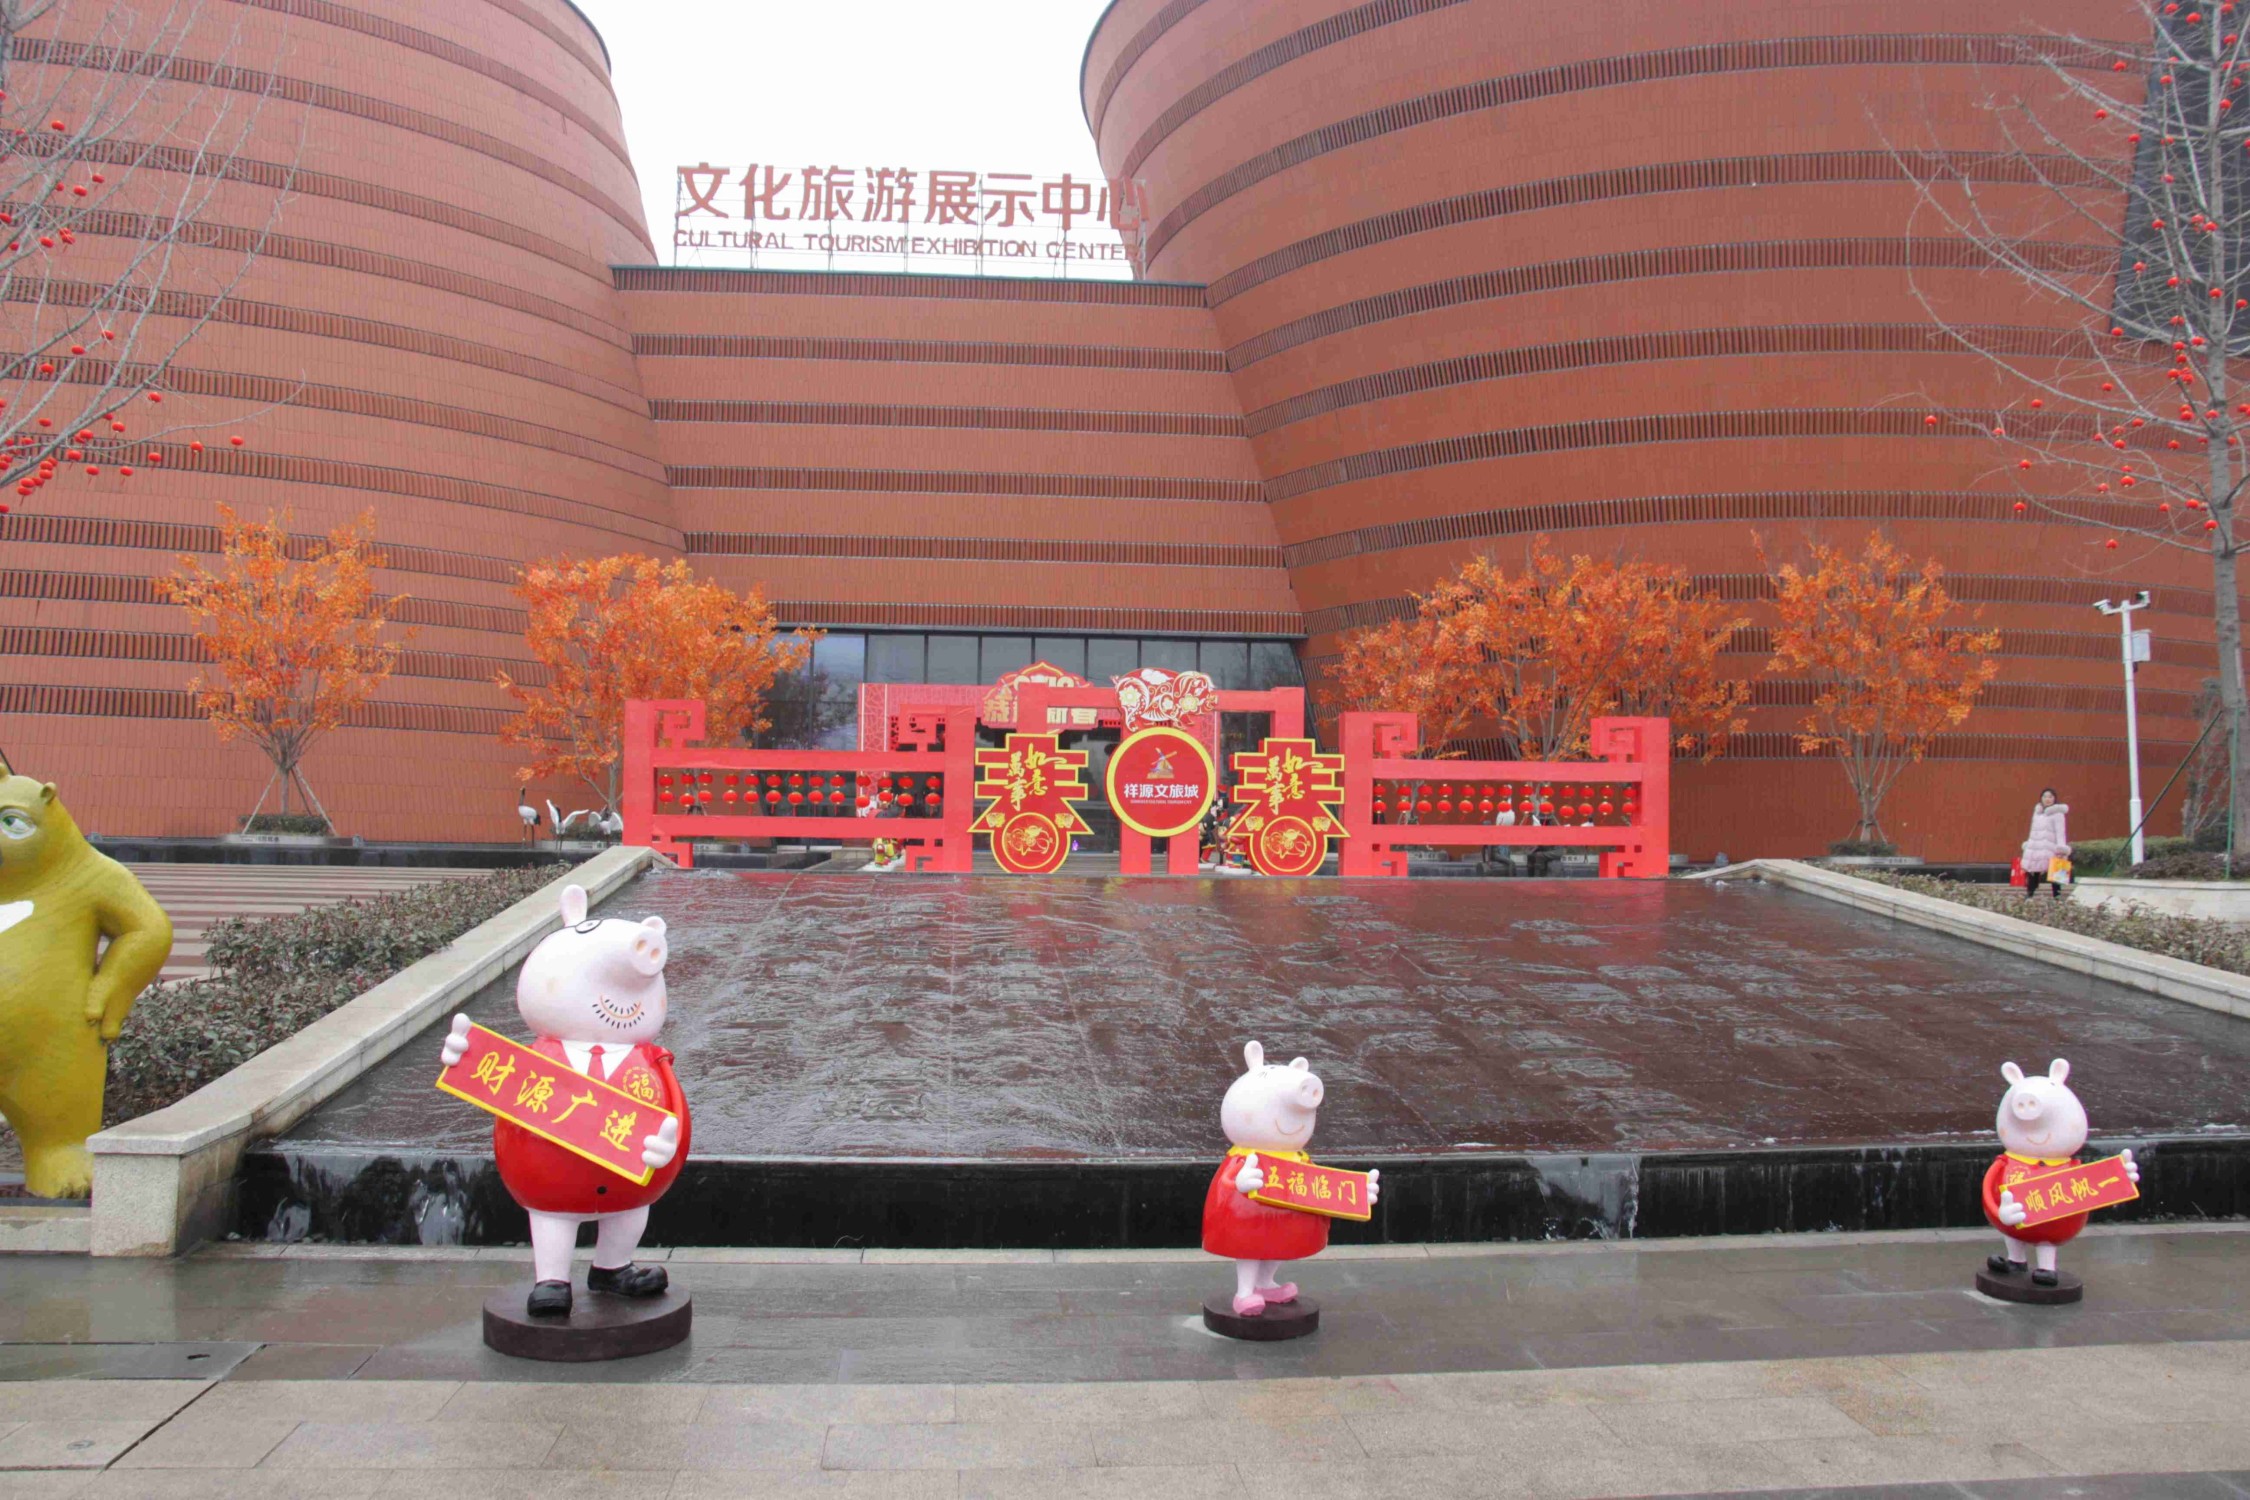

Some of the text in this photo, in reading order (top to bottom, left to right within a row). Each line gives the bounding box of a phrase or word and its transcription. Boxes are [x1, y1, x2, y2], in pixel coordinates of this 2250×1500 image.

[675, 162, 1150, 231] 文化旅游展示中心
[673, 229, 794, 249] CULTURAL
[804, 233, 904, 254] TOURISM
[911, 236, 1037, 258] EXHIBITION
[1124, 783, 1199, 798] 祥源文旅城
[470, 1051, 637, 1152] 财源广进
[628, 1072, 654, 1100] 福
[1265, 1166, 1357, 1205] 五福临门
